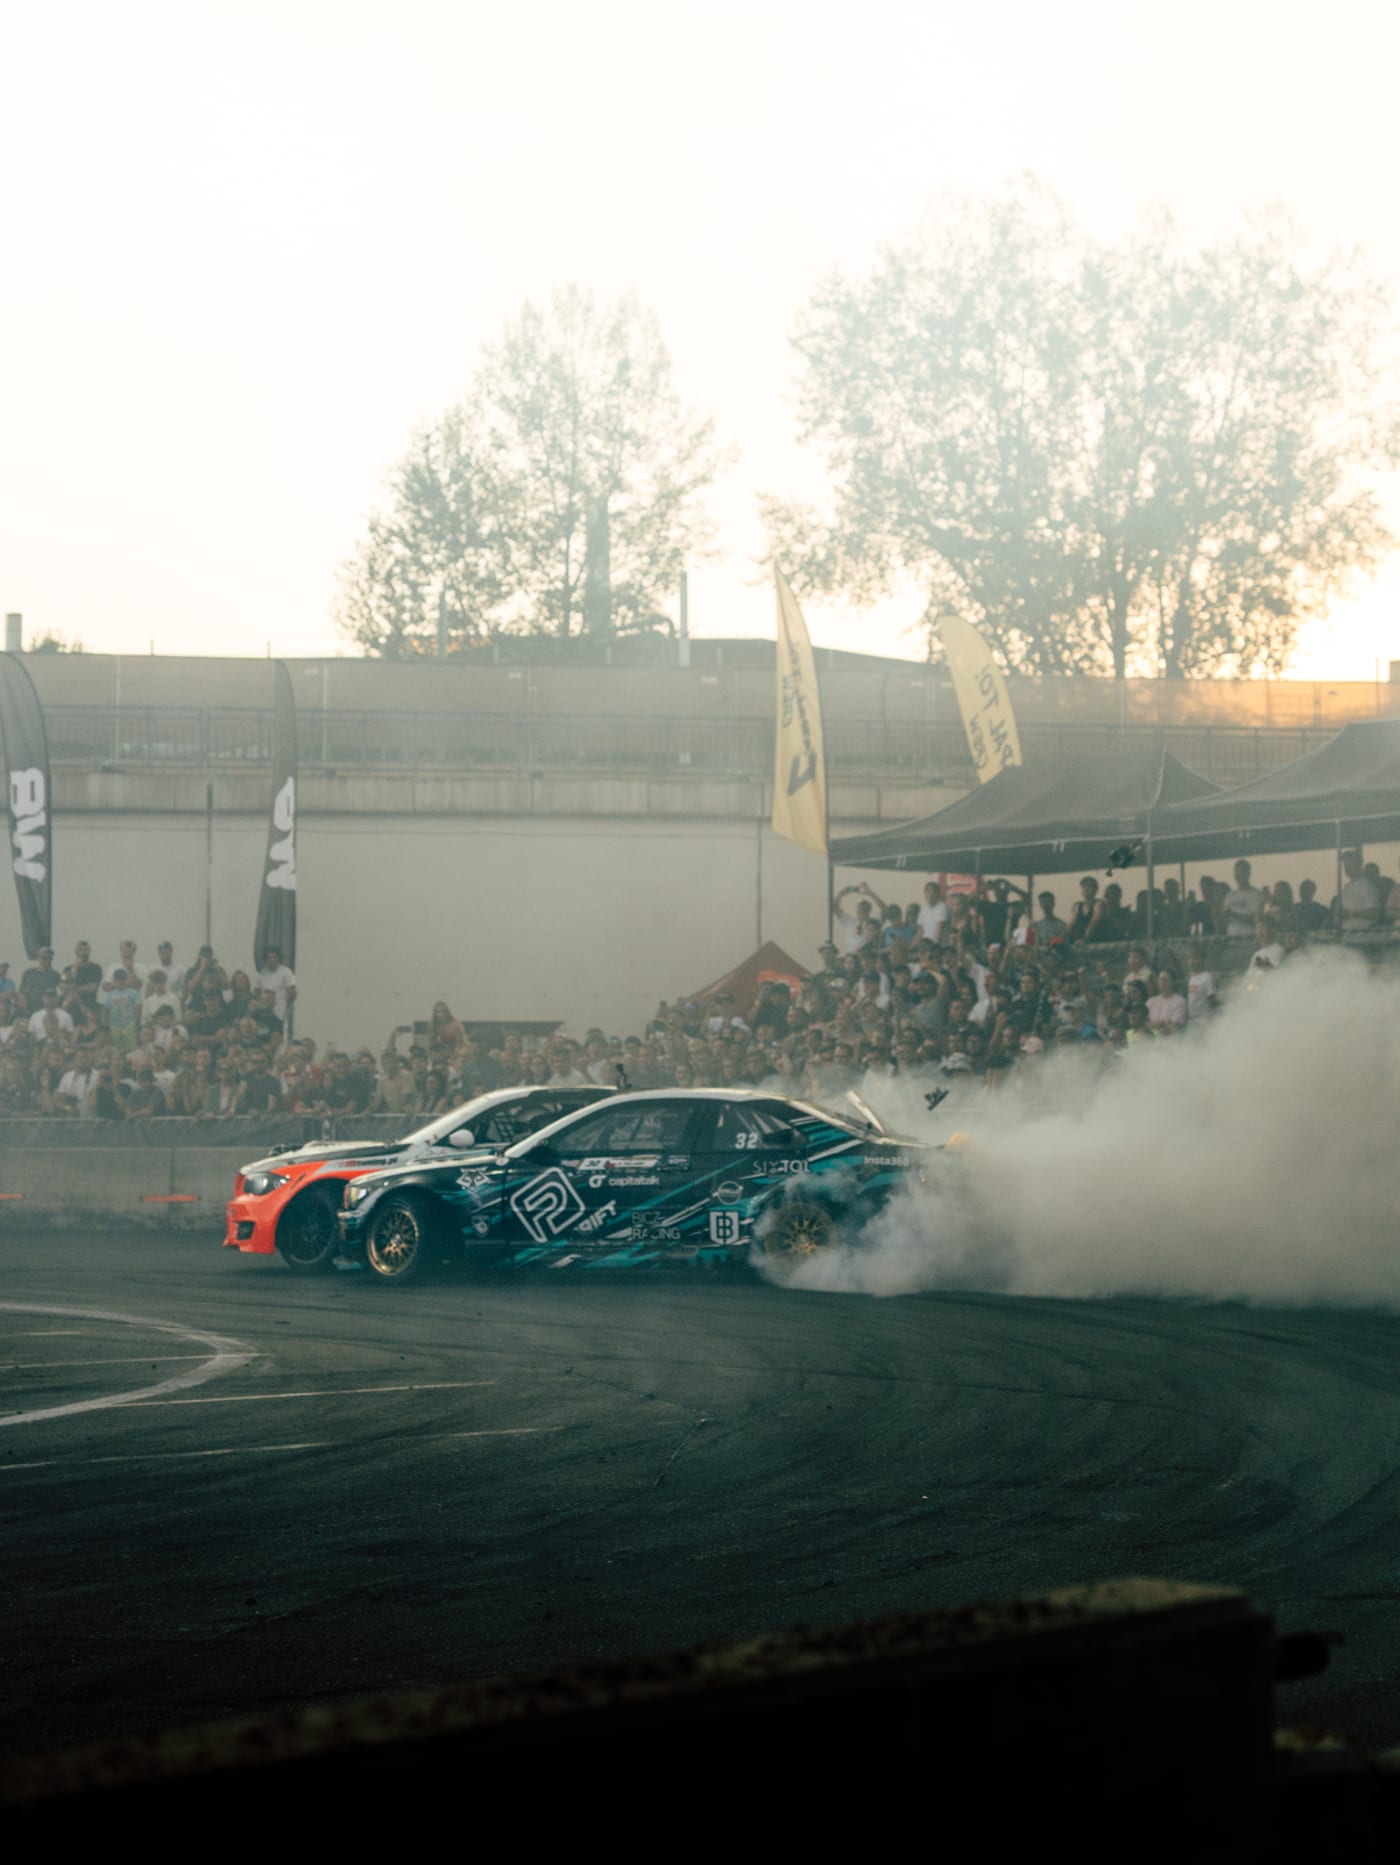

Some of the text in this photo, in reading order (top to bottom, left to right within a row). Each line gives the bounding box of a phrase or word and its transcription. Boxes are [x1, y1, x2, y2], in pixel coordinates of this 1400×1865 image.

[735, 1132, 758, 1149] 32
[752, 1160, 810, 1174] SIXTOL
[864, 1155, 910, 1167] Insta360
